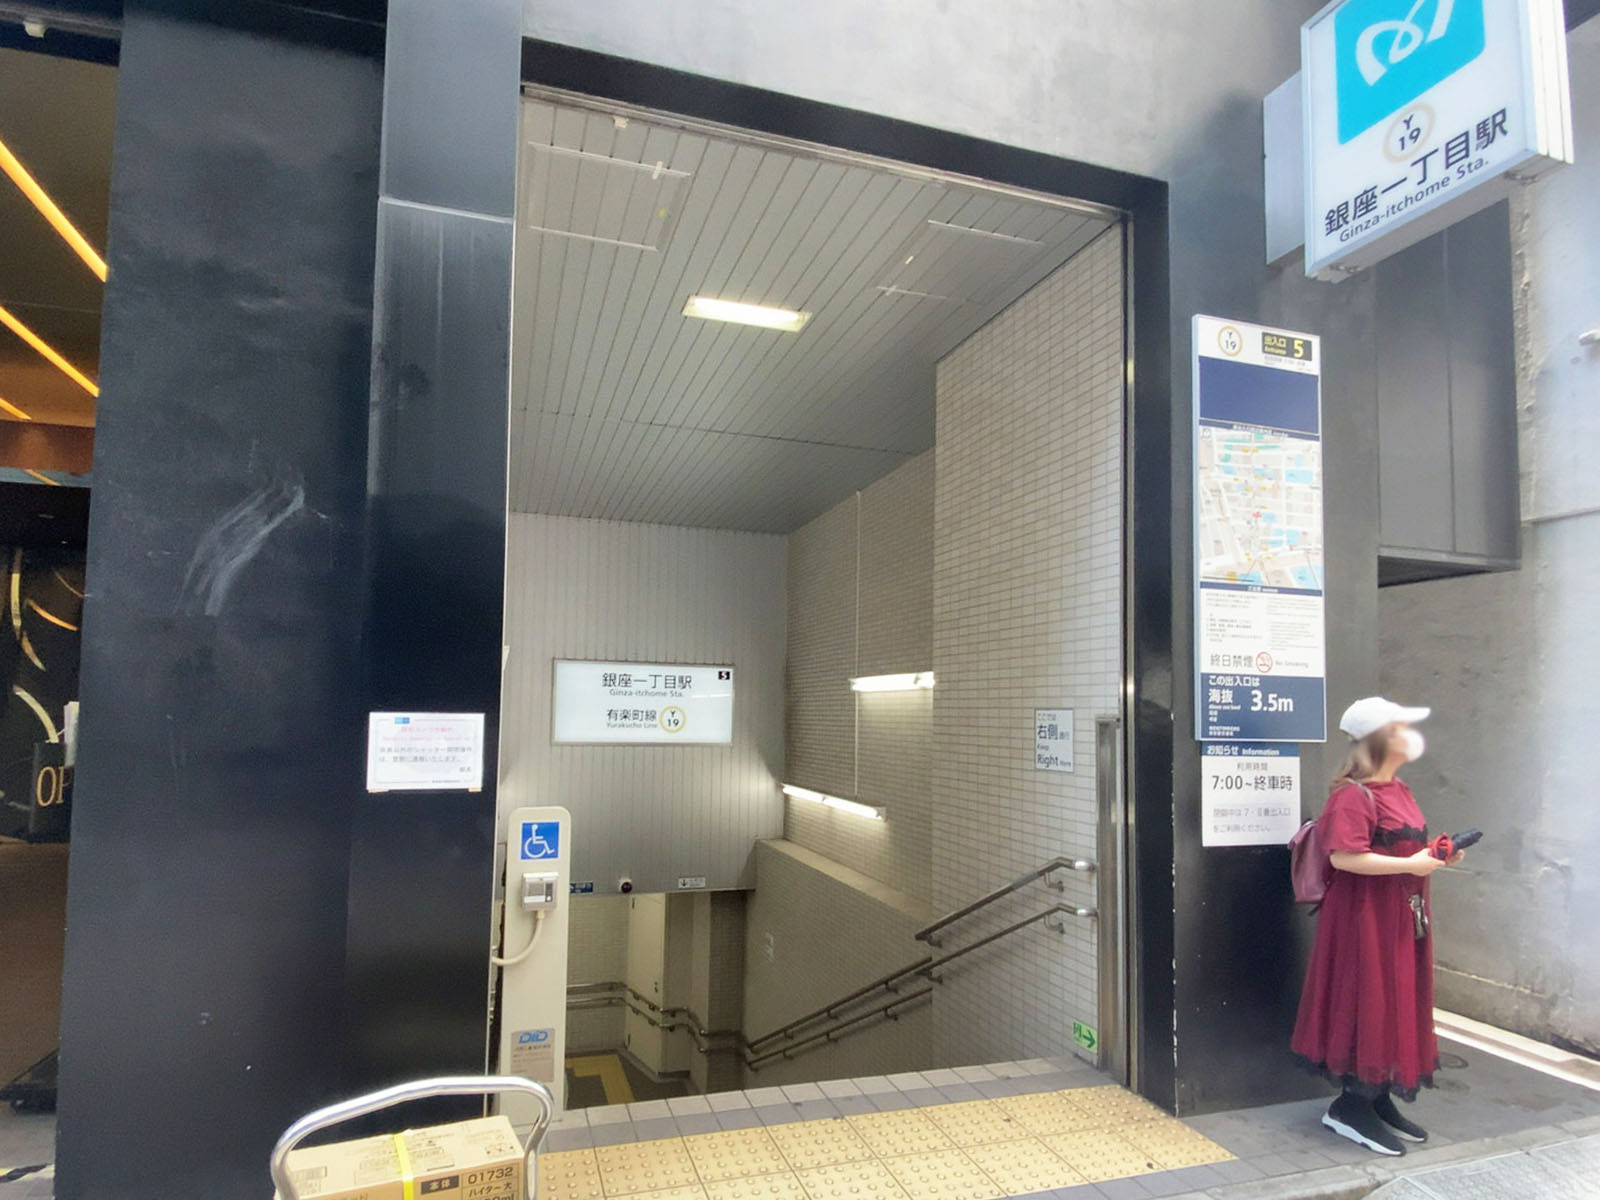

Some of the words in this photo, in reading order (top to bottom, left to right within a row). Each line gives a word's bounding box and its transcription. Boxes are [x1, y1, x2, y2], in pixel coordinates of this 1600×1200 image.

[1403, 114, 1414, 130] Y
[1398, 127, 1421, 151] 19
[1324, 108, 1508, 237] 銀座一丁目駅
[1339, 174, 1451, 243] Ginza-itchome
[1456, 158, 1490, 180] Sta.
[1293, 339, 1304, 358] 5
[602, 672, 692, 690] 銀座一丁目駅
[1208, 675, 1260, 687] この出入口は
[609, 689, 667, 698] Ginza-itchome
[669, 689, 685, 698] Sta.
[1250, 689, 1294, 712] 3.5m
[607, 709, 657, 722] 有楽町線
[667, 719, 679, 728] 19
[1207, 745, 1239, 756] お知らせ
[468, 1166, 514, 1184] 01732
